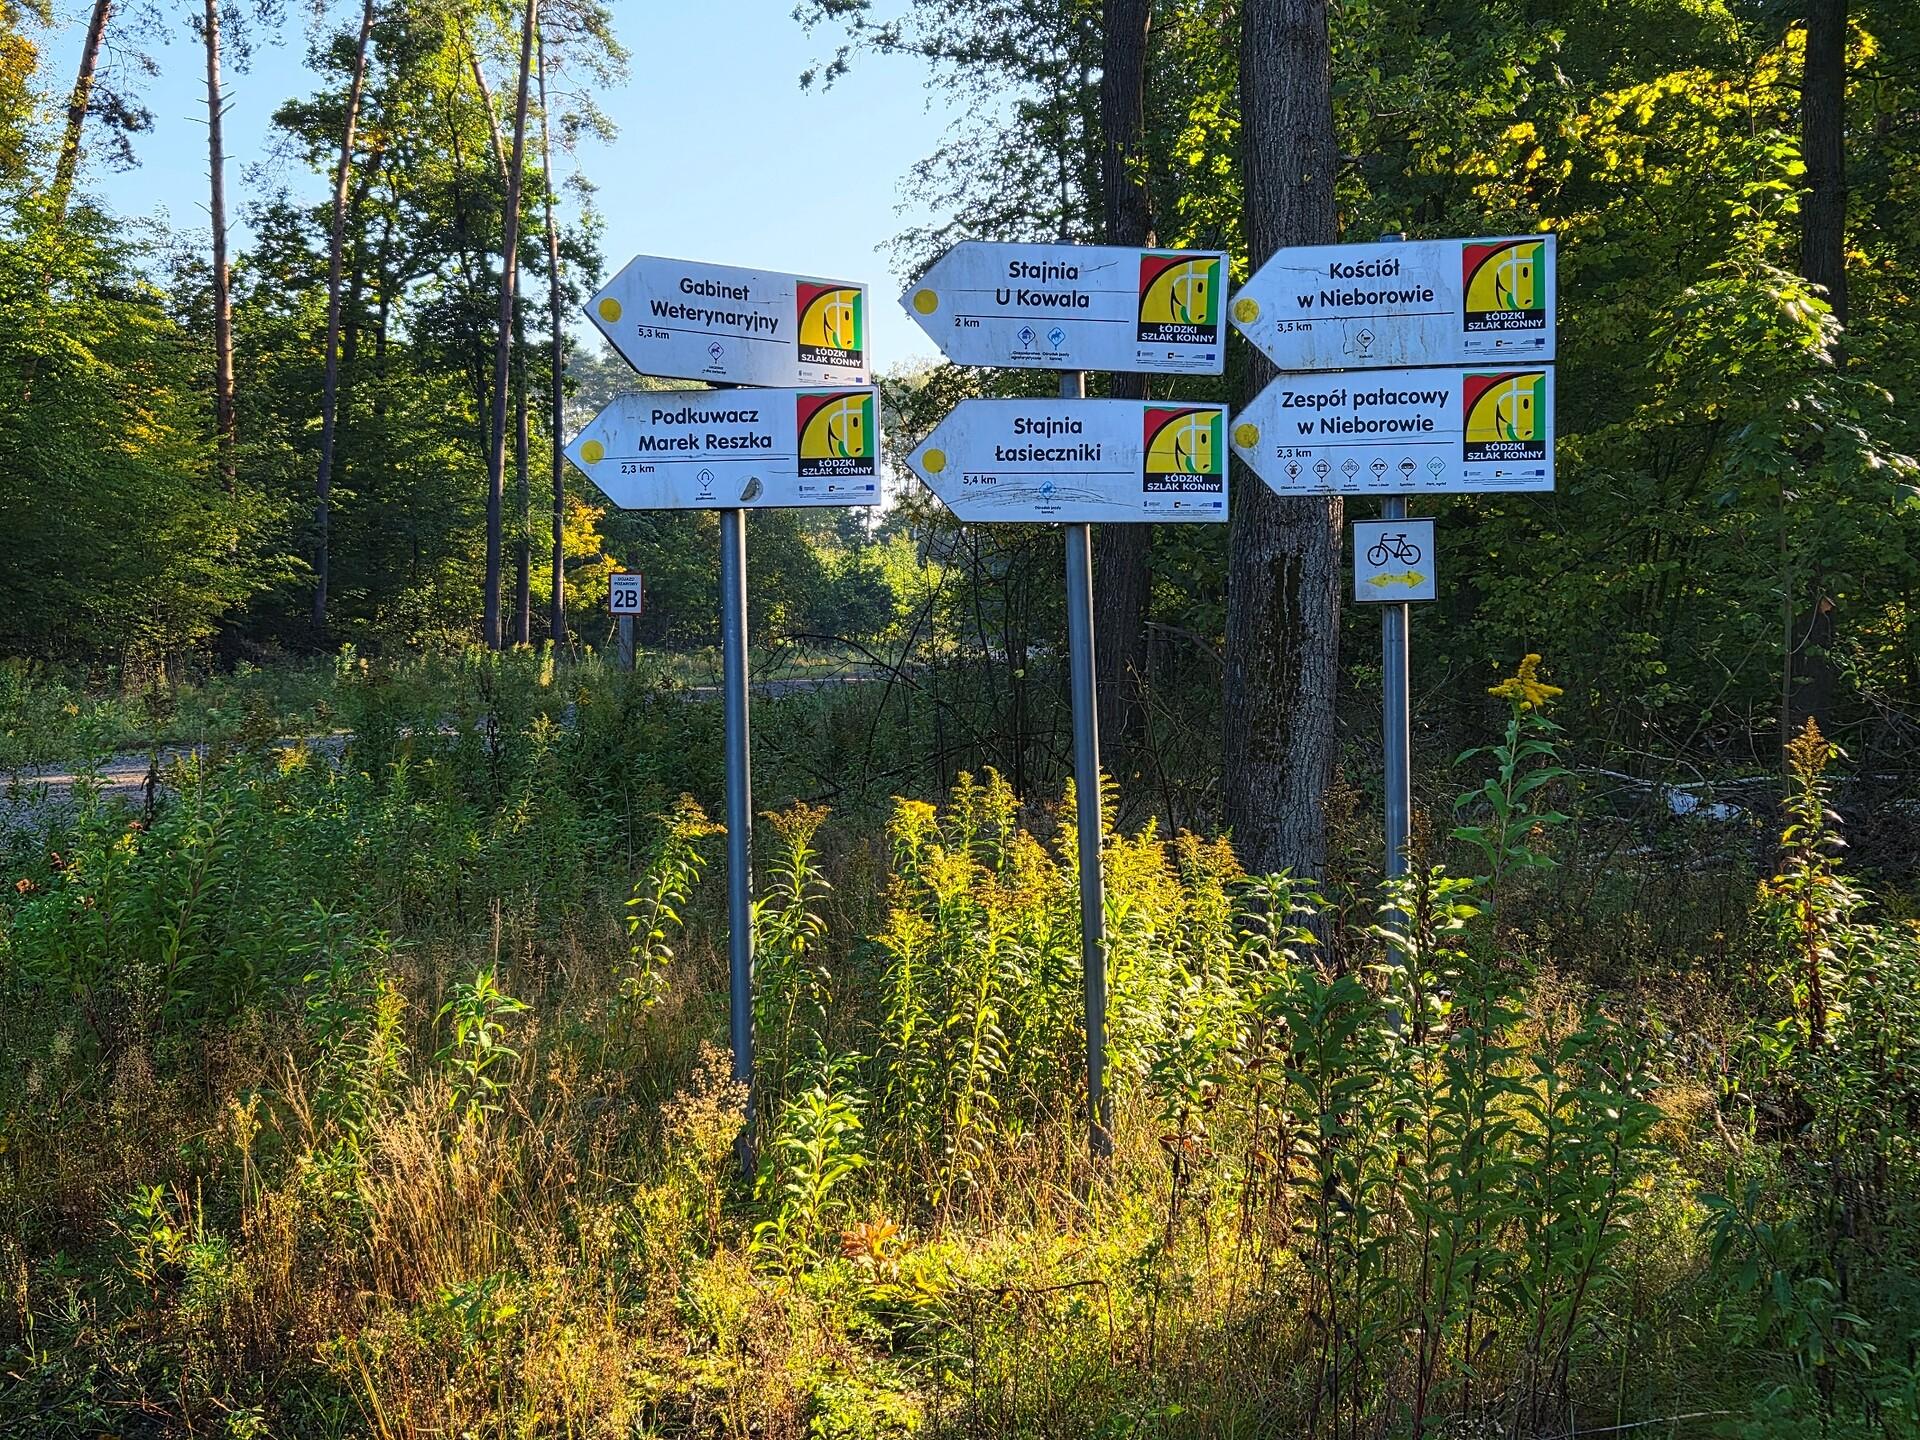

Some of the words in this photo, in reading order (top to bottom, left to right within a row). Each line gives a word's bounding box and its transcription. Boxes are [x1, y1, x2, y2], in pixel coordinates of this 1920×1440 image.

[1008, 260, 1079, 283] Stajnia
[1330, 258, 1400, 279] Kościół
[679, 277, 750, 301] Gabinet
[996, 289, 1010, 306] U
[1017, 289, 1089, 308] Kowala
[1298, 295, 1313, 308] w
[1320, 285, 1434, 307] Nieborowie
[650, 300, 778, 333] Weterynaryjny
[1485, 311, 1525, 321] ŁÓDZKI
[955, 318, 961, 327] 2
[964, 318, 980, 328] km
[1159, 324, 1197, 334] ŁÓDZKI
[1277, 322, 1293, 333] 3,5
[1296, 322, 1312, 331] km
[1468, 321, 1500, 331] SZLAK
[1503, 319, 1543, 330] KONNY
[638, 327, 653, 338] 5,3
[655, 329, 670, 340] km
[1141, 332, 1173, 341] SZLAK
[1176, 333, 1215, 343] KONNY
[815, 347, 847, 358] ŁÓDZKI
[801, 353, 828, 364] SZLAK
[830, 356, 861, 367] KONNY
[1282, 389, 1348, 411] Zespół
[1353, 388, 1449, 409] pałacowy
[651, 407, 759, 425] Podkuwacz
[1013, 417, 1082, 439] Stajnia
[1297, 422, 1313, 435] w
[1320, 414, 1434, 434] Nieborowie
[638, 433, 700, 451] Marek
[706, 433, 772, 450] Reszka
[1485, 441, 1525, 451] ŁÓDZKI
[995, 444, 1101, 462] Łasieczniki
[1277, 448, 1293, 460] 2,3
[1296, 448, 1312, 458] km
[1467, 451, 1500, 461] SZLAK
[1503, 450, 1543, 460] KONNY
[818, 458, 855, 468] ŁÓDZKI
[621, 464, 637, 475] 2,3
[639, 464, 655, 473] km
[802, 467, 833, 476] SZLAK
[836, 466, 873, 475] KONNY
[963, 475, 979, 486] 5,4
[980, 475, 997, 485] km
[1165, 473, 1203, 483] ŁÓDZKI
[1147, 482, 1180, 491] SZLAK
[1182, 482, 1220, 491] KONNY
[614, 589, 638, 608] 2B
